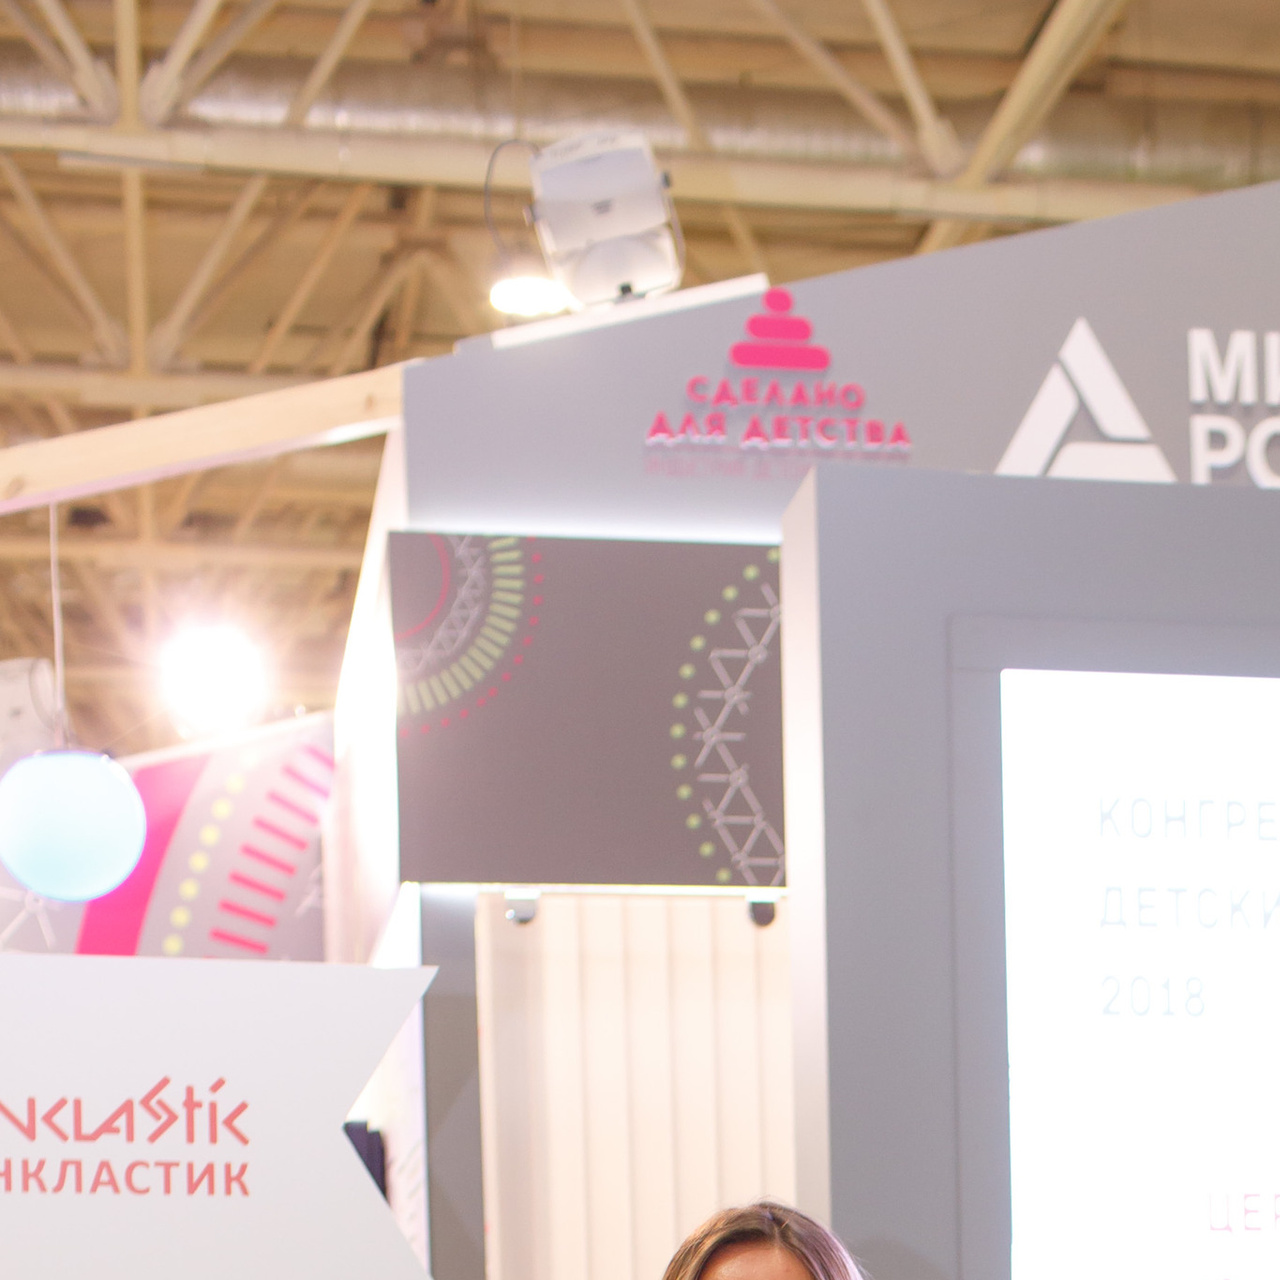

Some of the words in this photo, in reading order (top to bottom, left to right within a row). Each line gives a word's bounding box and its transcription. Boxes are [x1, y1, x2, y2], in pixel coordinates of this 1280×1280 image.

[686, 376, 866, 413] СДЕЛАНО
[645, 411, 728, 447] ДЛЯ
[738, 414, 914, 453] ДЕТСТВА
[1101, 976, 1206, 1018] 2018
